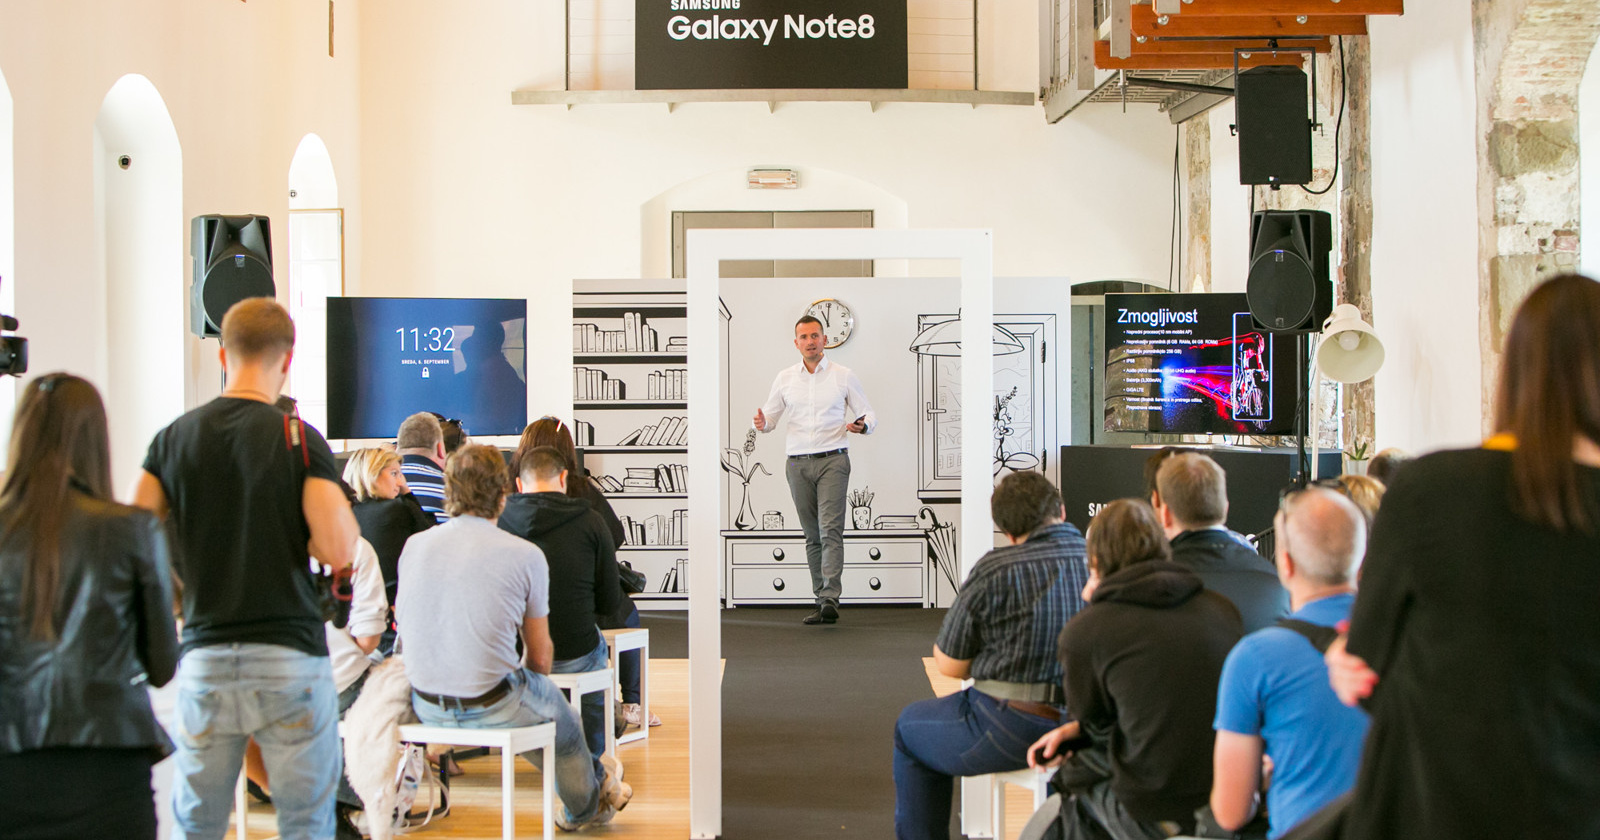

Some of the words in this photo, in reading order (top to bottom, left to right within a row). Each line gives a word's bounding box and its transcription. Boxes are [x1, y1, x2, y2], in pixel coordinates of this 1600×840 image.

[671, 0, 741, 10] SAMSUNG
[667, 15, 778, 46] Galaxy
[784, 13, 876, 39] Note8
[1117, 308, 1198, 327] Zmogljivost
[396, 327, 456, 352] 11:32
